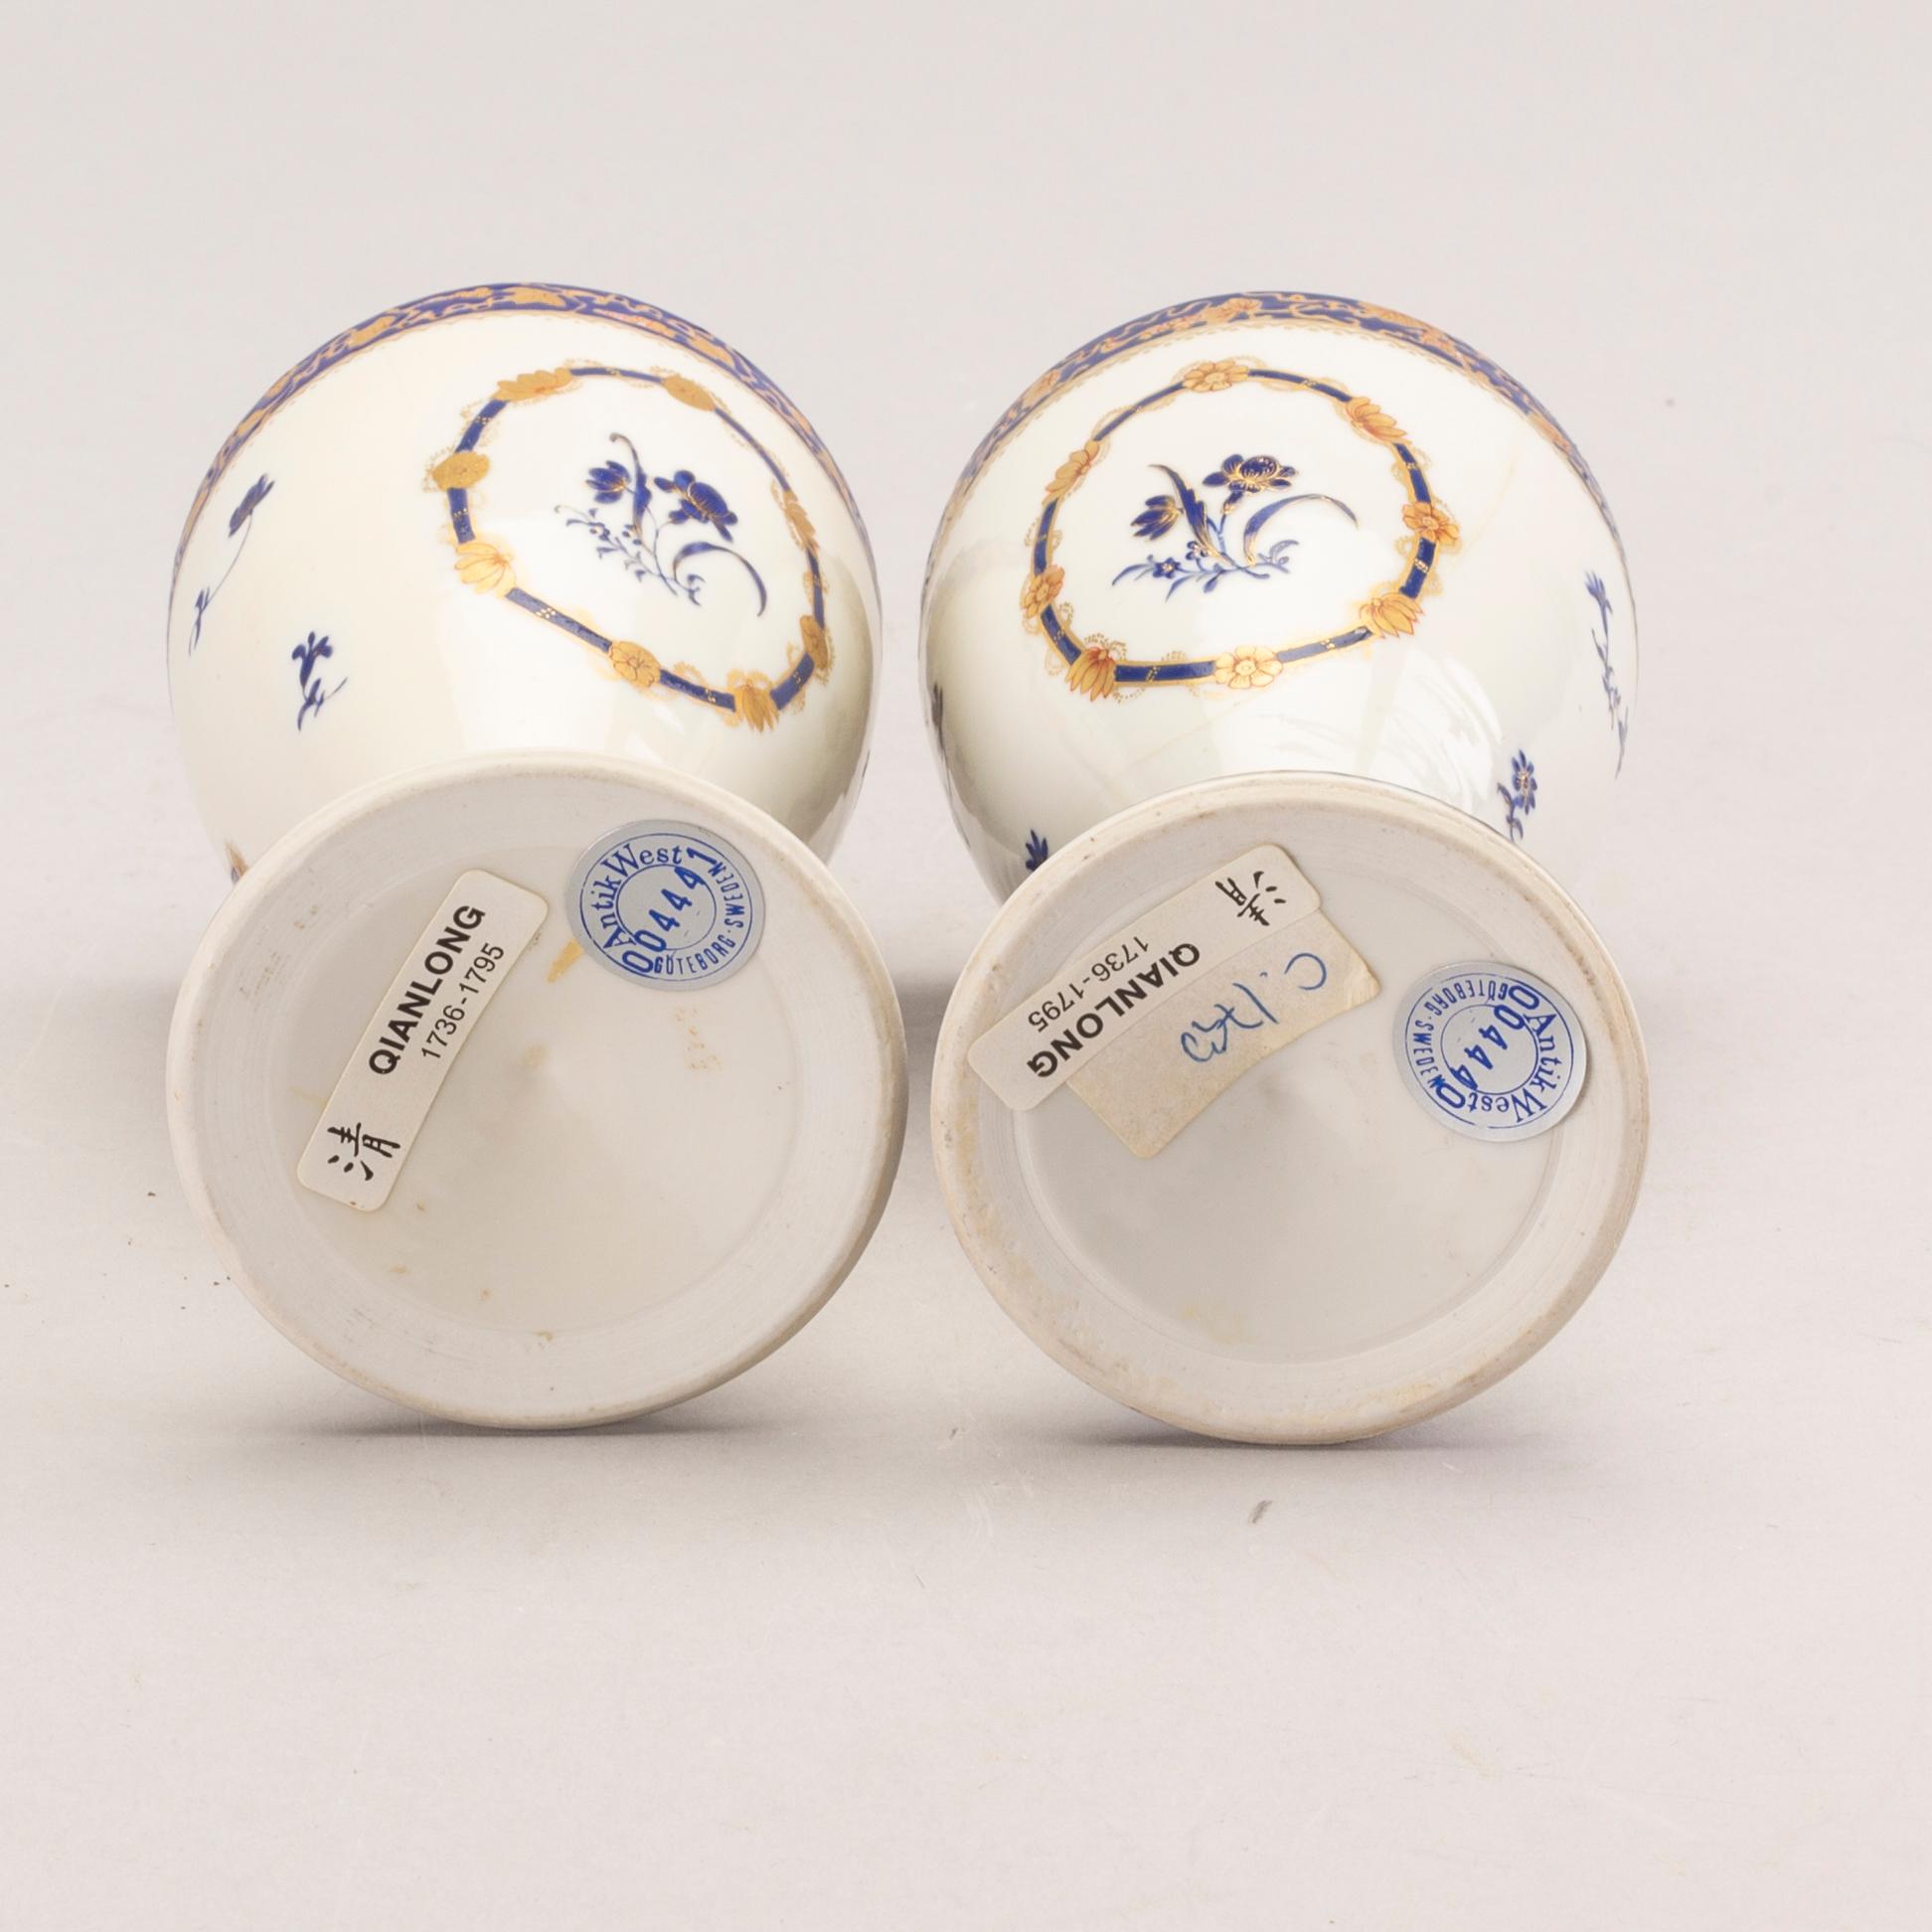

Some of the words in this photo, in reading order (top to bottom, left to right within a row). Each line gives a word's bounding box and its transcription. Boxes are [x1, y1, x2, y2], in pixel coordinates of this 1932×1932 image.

[622, 847, 720, 973] 004441
[1215, 871, 1286, 926] 清
[369, 905, 486, 1075] QIANLONG
[421, 942, 505, 1059] 1736-1795
[1027, 943, 1201, 1078] QIANLONG
[1028, 936, 1149, 1033] 1736-1795
[1435, 984, 1540, 1109] 004440
[327, 1122, 402, 1181] 清
